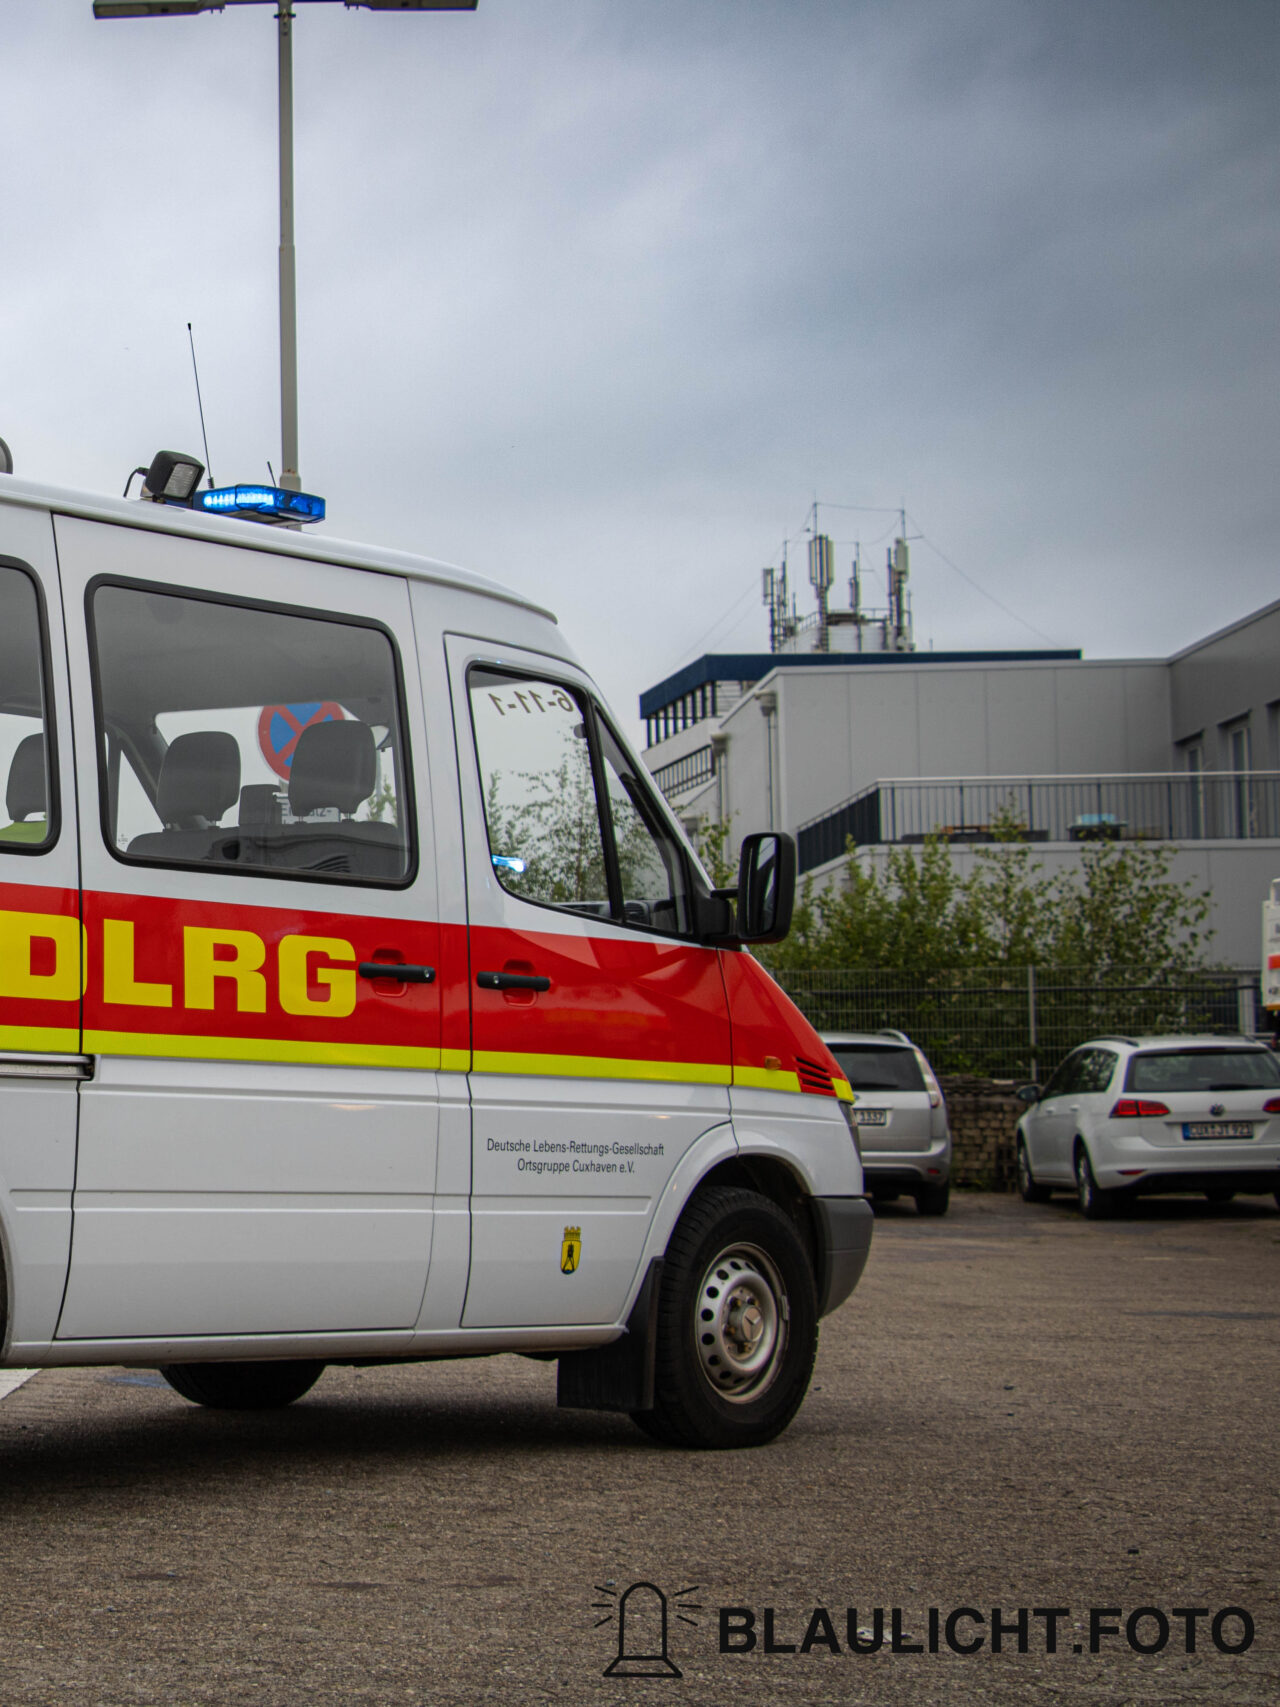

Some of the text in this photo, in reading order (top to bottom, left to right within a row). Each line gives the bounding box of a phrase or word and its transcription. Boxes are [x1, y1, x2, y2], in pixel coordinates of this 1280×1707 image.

[487, 1138, 665, 1157] Deutsche Lebens-Rettungs-Gesellschaft
[517, 1158, 635, 1174] Ortsgruppe Cuxhaven e.V.
